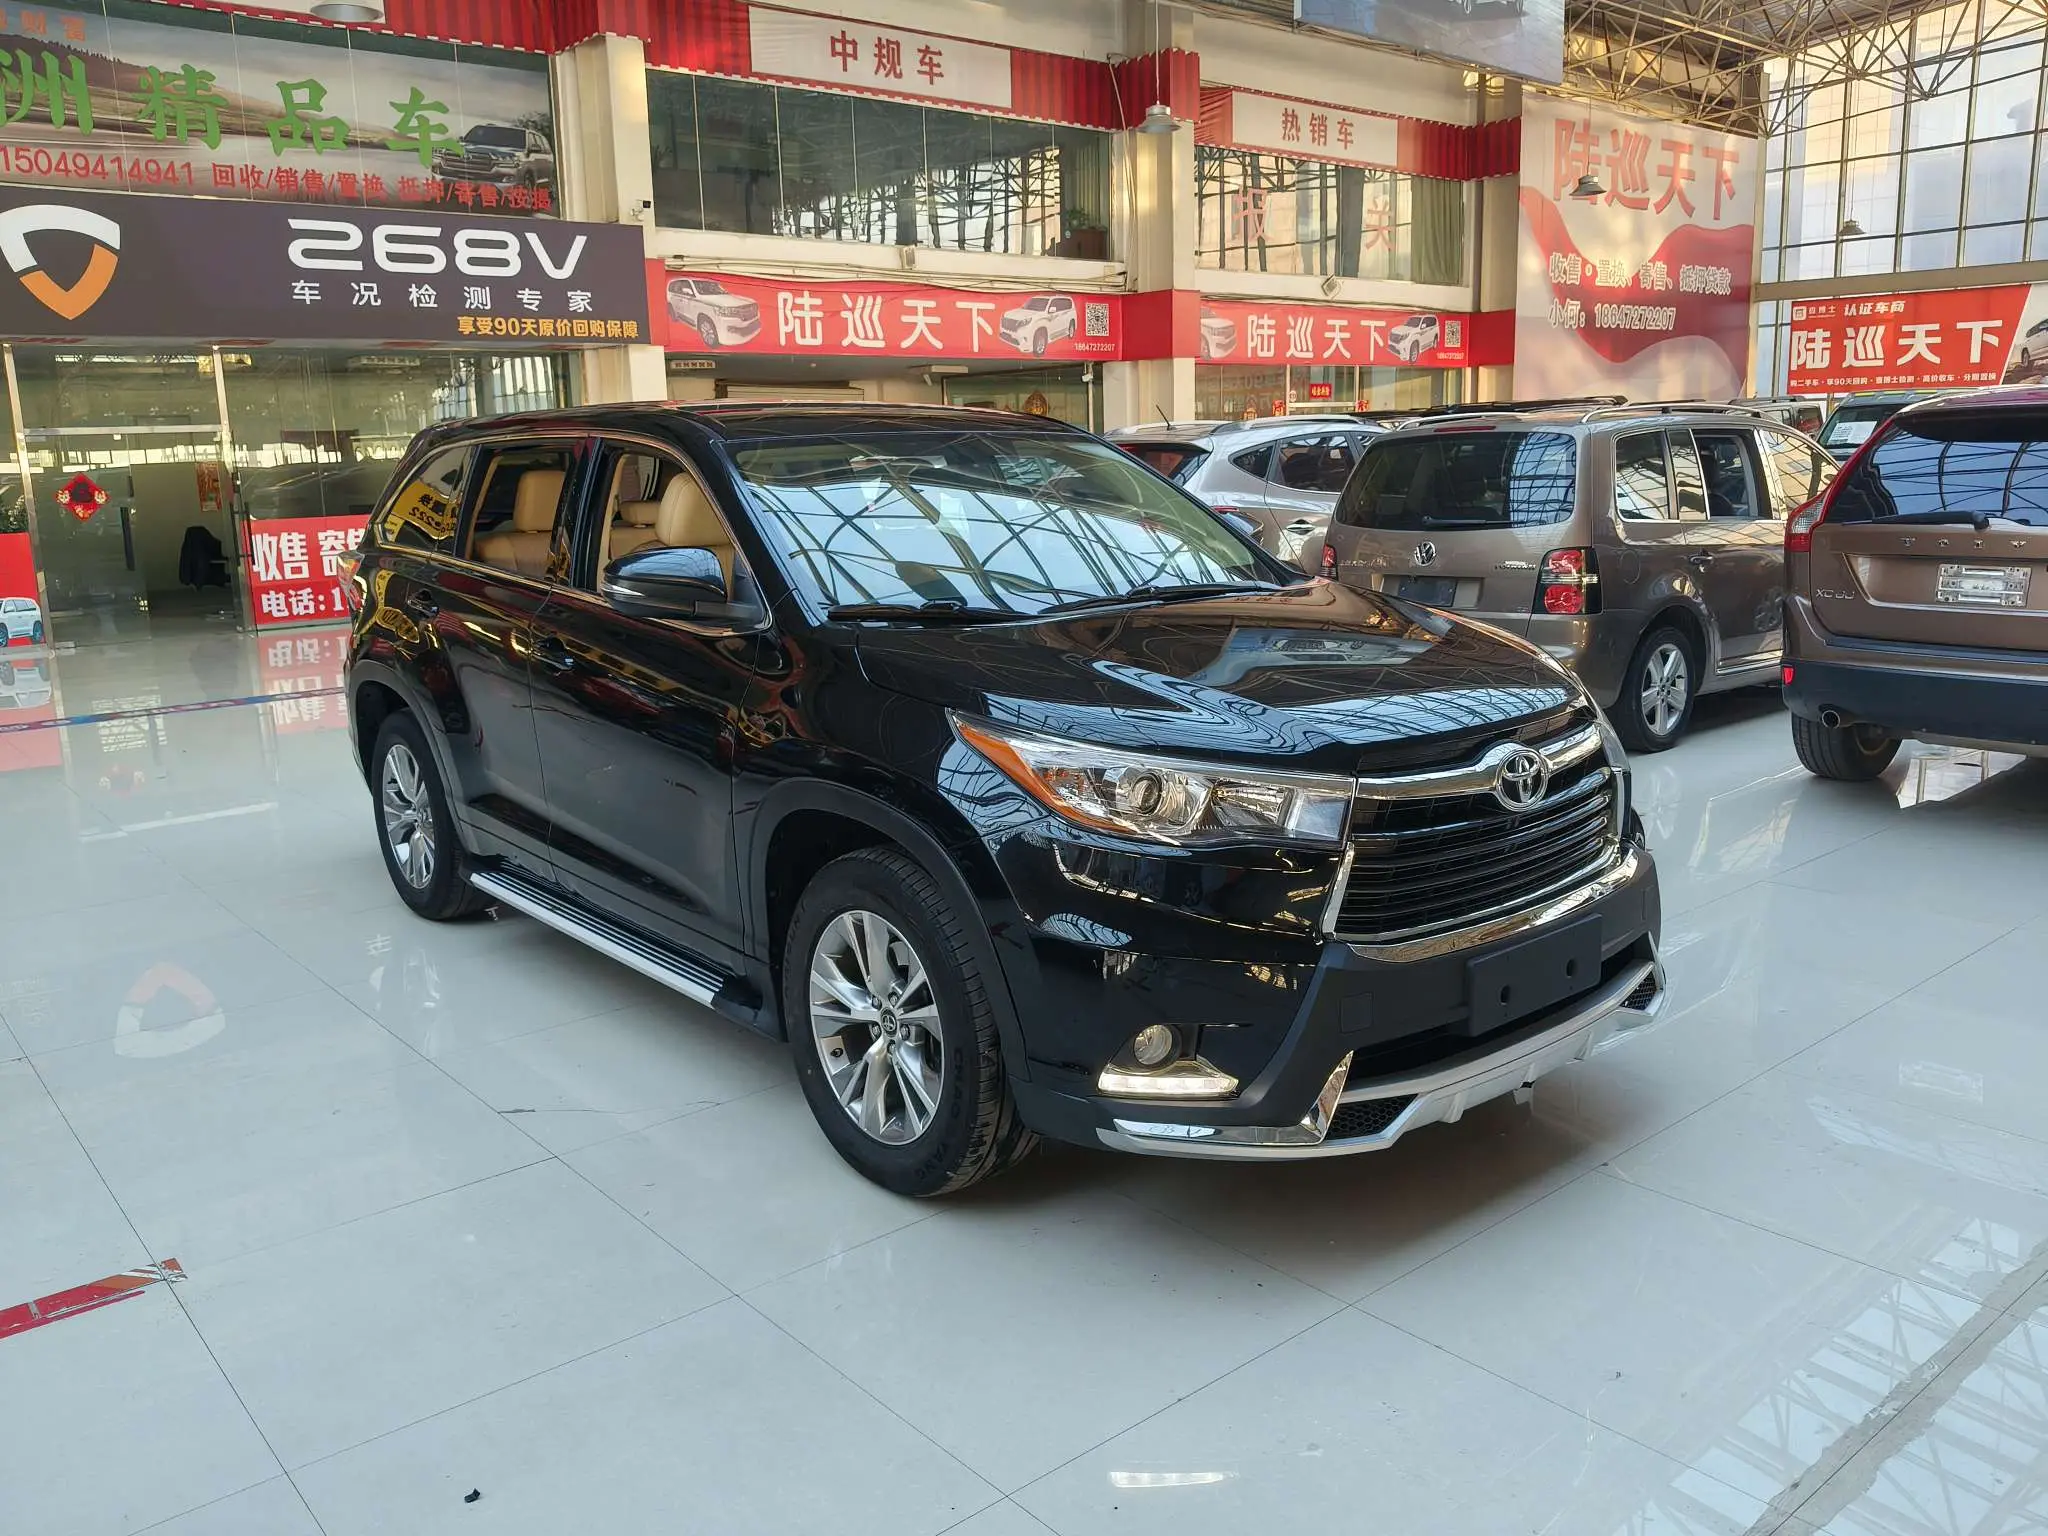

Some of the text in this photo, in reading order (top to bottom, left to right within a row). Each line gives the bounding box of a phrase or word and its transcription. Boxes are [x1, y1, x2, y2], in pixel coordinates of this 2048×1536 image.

[830, 30, 944, 85] 中规车
[1281, 108, 1354, 149] 热销车
[0, 145, 194, 186] 15049414941
[1552, 118, 1740, 221] 陆巡天下
[287, 218, 588, 280] 268V
[291, 279, 593, 313] 车况检测专家
[456, 316, 640, 339] 享受90天原价回购保障
[778, 291, 996, 353] 陆巡天下
[1247, 314, 1387, 361] 陆巡天下
[1789, 319, 2004, 371] 陆巡天下
[251, 532, 310, 582] 收售
